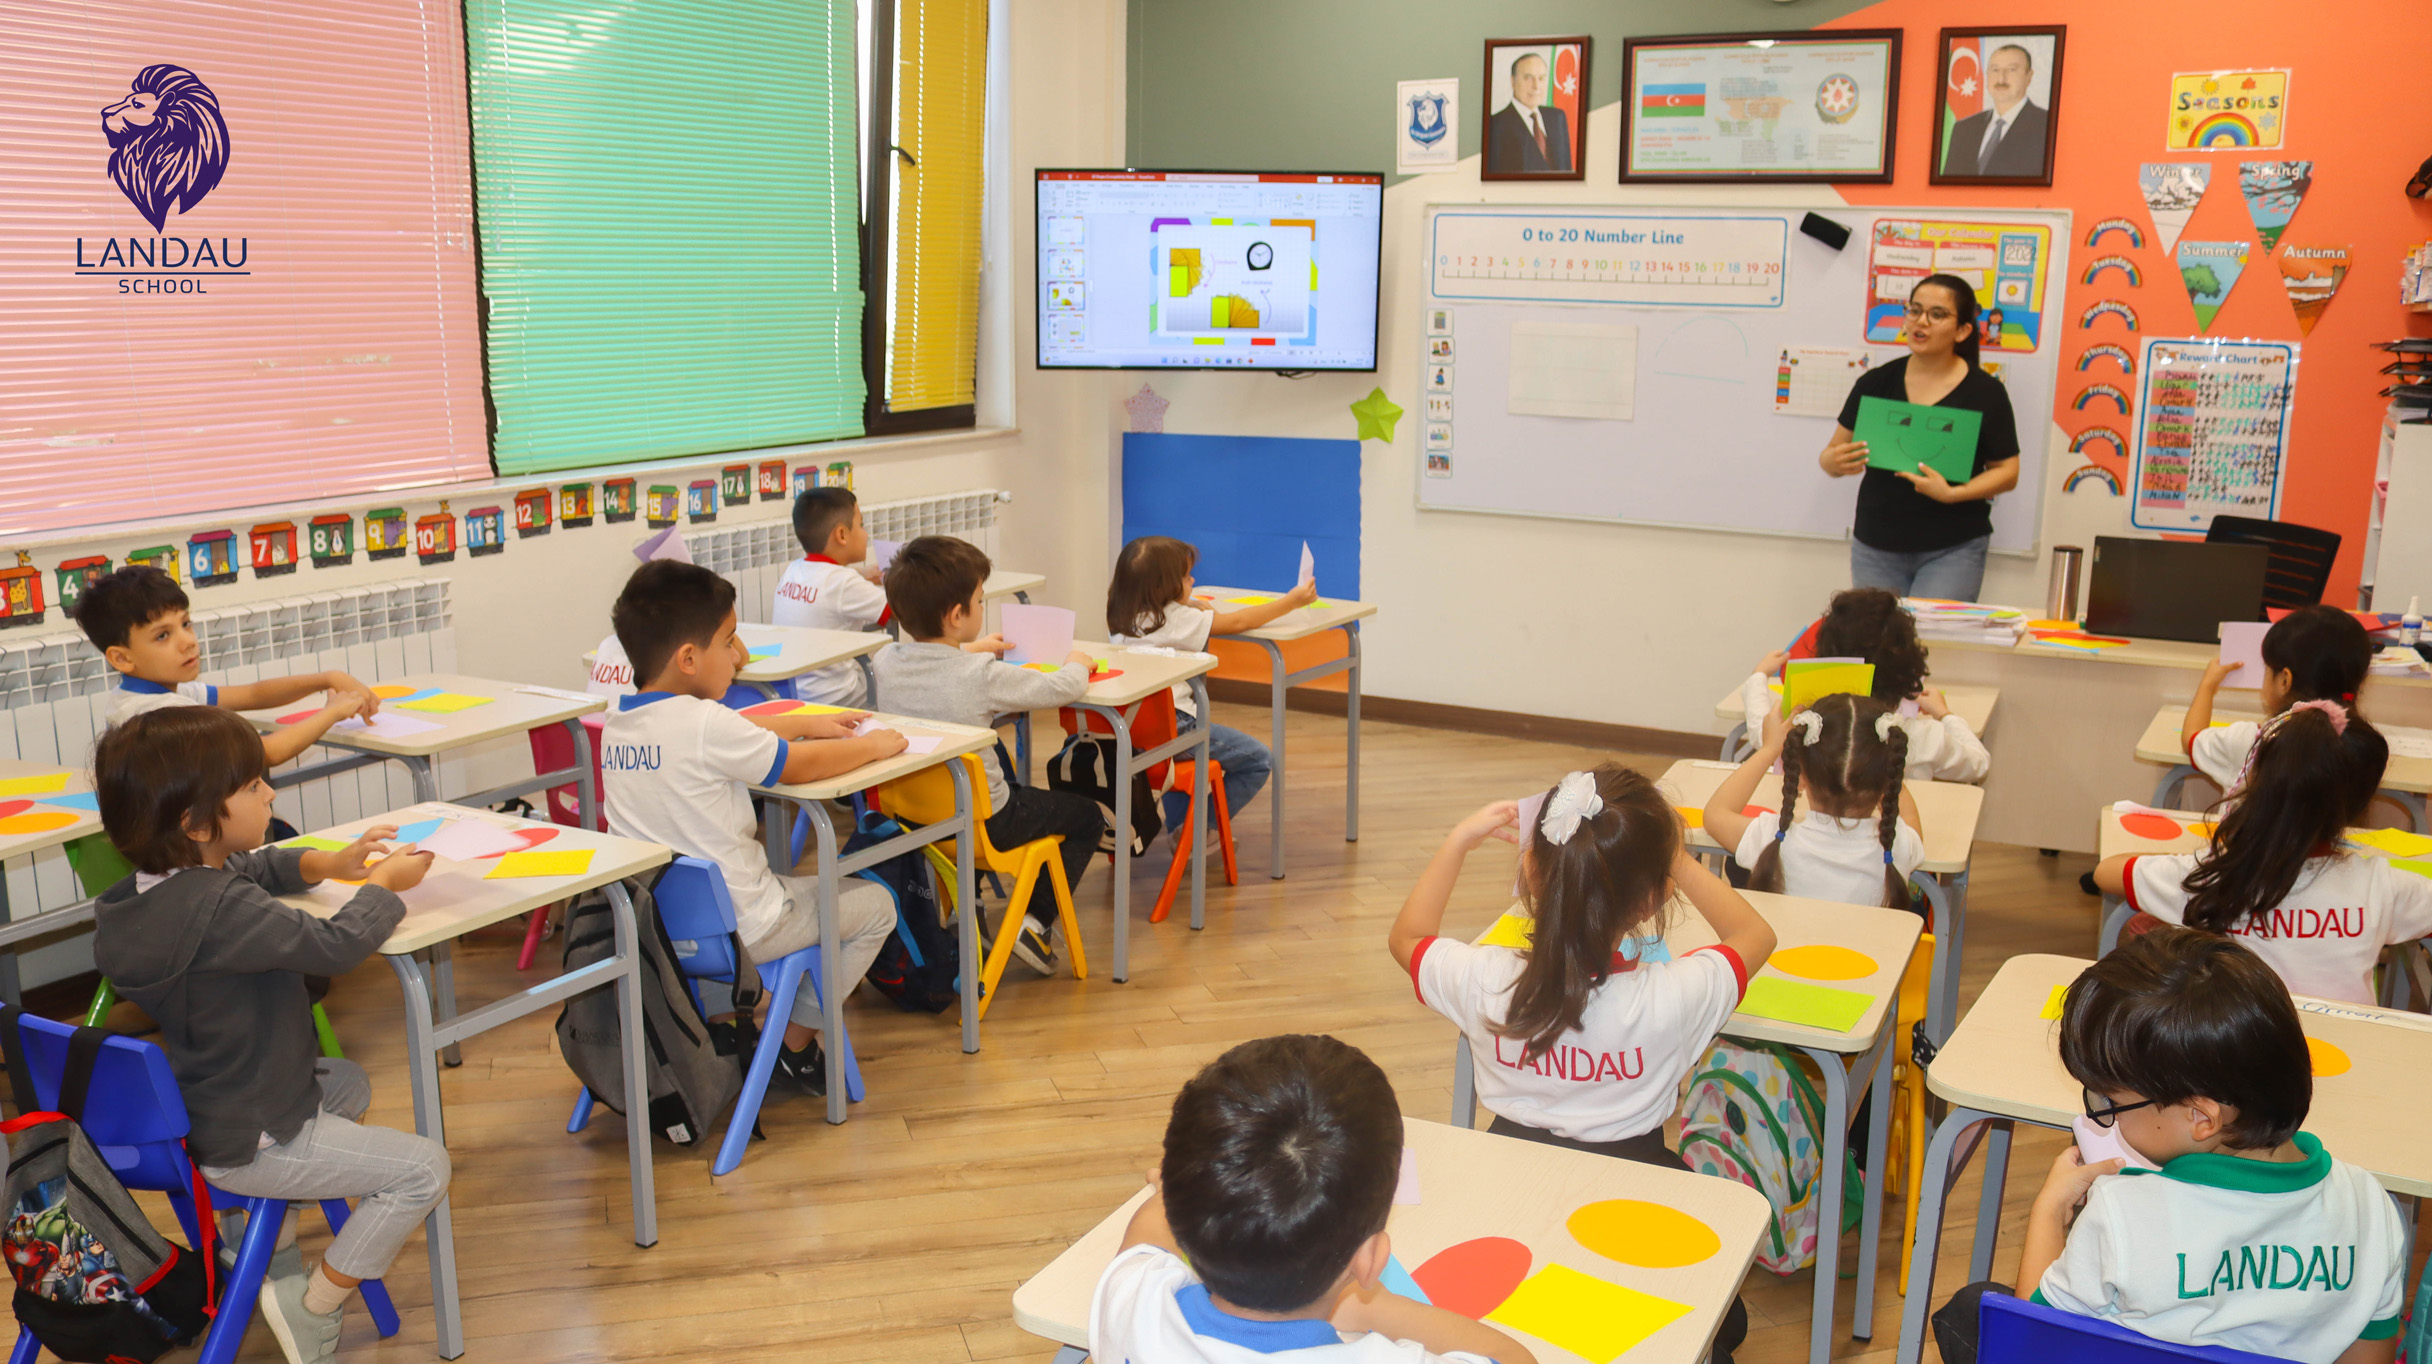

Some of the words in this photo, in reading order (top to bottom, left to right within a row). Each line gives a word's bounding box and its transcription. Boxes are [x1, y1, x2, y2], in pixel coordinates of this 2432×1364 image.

[2177, 92, 2280, 111] Seasons
[2149, 163, 2202, 178] Winter
[2251, 163, 2301, 181] Spring
[1523, 228, 1533, 242] 0
[1538, 229, 1554, 242] to
[1559, 228, 1579, 242] 20
[1584, 229, 1646, 243] Number
[1652, 230, 1685, 244] Line
[2096, 218, 2137, 235] Monday
[2182, 243, 2244, 256] Summer
[2283, 245, 2347, 259] Autumn
[1440, 255, 1448, 266] 0
[1457, 256, 1462, 266] 1
[1471, 256, 1478, 267] 2
[1487, 256, 1494, 267] 3
[1502, 257, 1509, 267] 4
[1518, 257, 1525, 268] 5
[1533, 258, 1541, 268] 6
[1550, 259, 1557, 269] 7
[1566, 259, 1573, 270] 8
[1582, 259, 1589, 270] 9
[1595, 259, 1608, 270] 10
[1613, 260, 1623, 271] 11
[1629, 261, 1641, 272] 12
[1646, 261, 1657, 272] 13
[1662, 261, 1674, 273] 14
[1679, 262, 1691, 273] 15
[1695, 262, 1707, 273] 16
[1713, 262, 1725, 273] 17
[1729, 262, 1741, 274] 18
[1747, 262, 1759, 274] 19
[1764, 263, 1780, 274] 20
[2091, 256, 2134, 273] Tuesday
[2083, 301, 2136, 322] Wednesday
[2084, 345, 2129, 362] Thursday
[2180, 352, 2222, 364] Reward
[2225, 353, 2258, 364] Chart
[2088, 384, 2120, 400] Friday
[2077, 428, 2121, 446] Saturday
[759, 472, 771, 489] 18
[2076, 466, 2113, 482] Sunday
[723, 477, 735, 495] 17
[794, 478, 806, 497] 19
[561, 496, 576, 515] 13
[604, 490, 618, 510] 14
[649, 498, 661, 516] 15
[688, 493, 701, 512] 16
[516, 504, 532, 524] 12
[313, 529, 327, 553] 8
[368, 524, 381, 545] 9
[417, 528, 434, 550] 10
[467, 522, 482, 543] 11
[193, 548, 209, 572] 6
[254, 538, 268, 563] 7
[62, 575, 79, 599] 4
[777, 581, 819, 604] ANDAU
[601, 744, 662, 770] ANDAU
[1494, 1034, 1643, 1082] LANDAU
[2175, 1244, 2356, 1300] LANDAU
